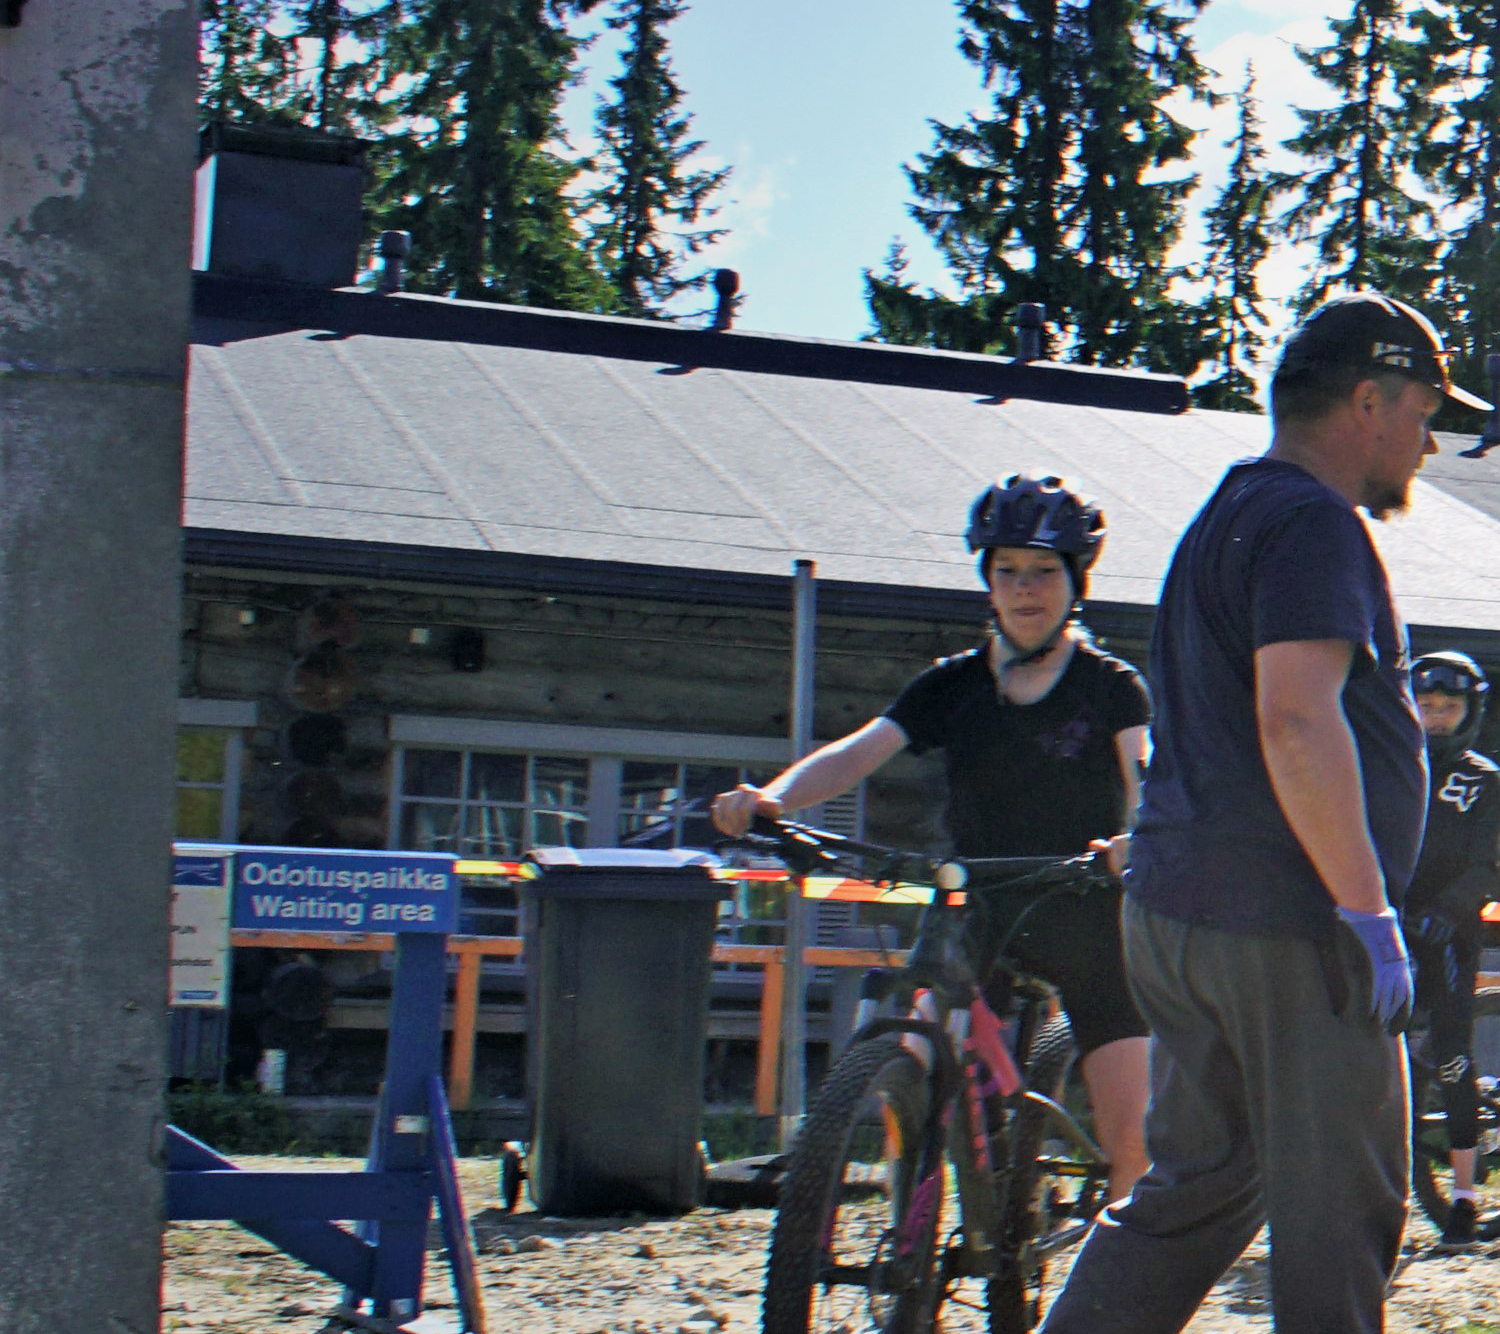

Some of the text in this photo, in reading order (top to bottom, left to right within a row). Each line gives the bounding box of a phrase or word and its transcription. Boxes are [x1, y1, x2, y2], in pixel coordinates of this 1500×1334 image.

[242, 861, 449, 893] Odotuspaikka
[251, 895, 437, 925] Waiting area
